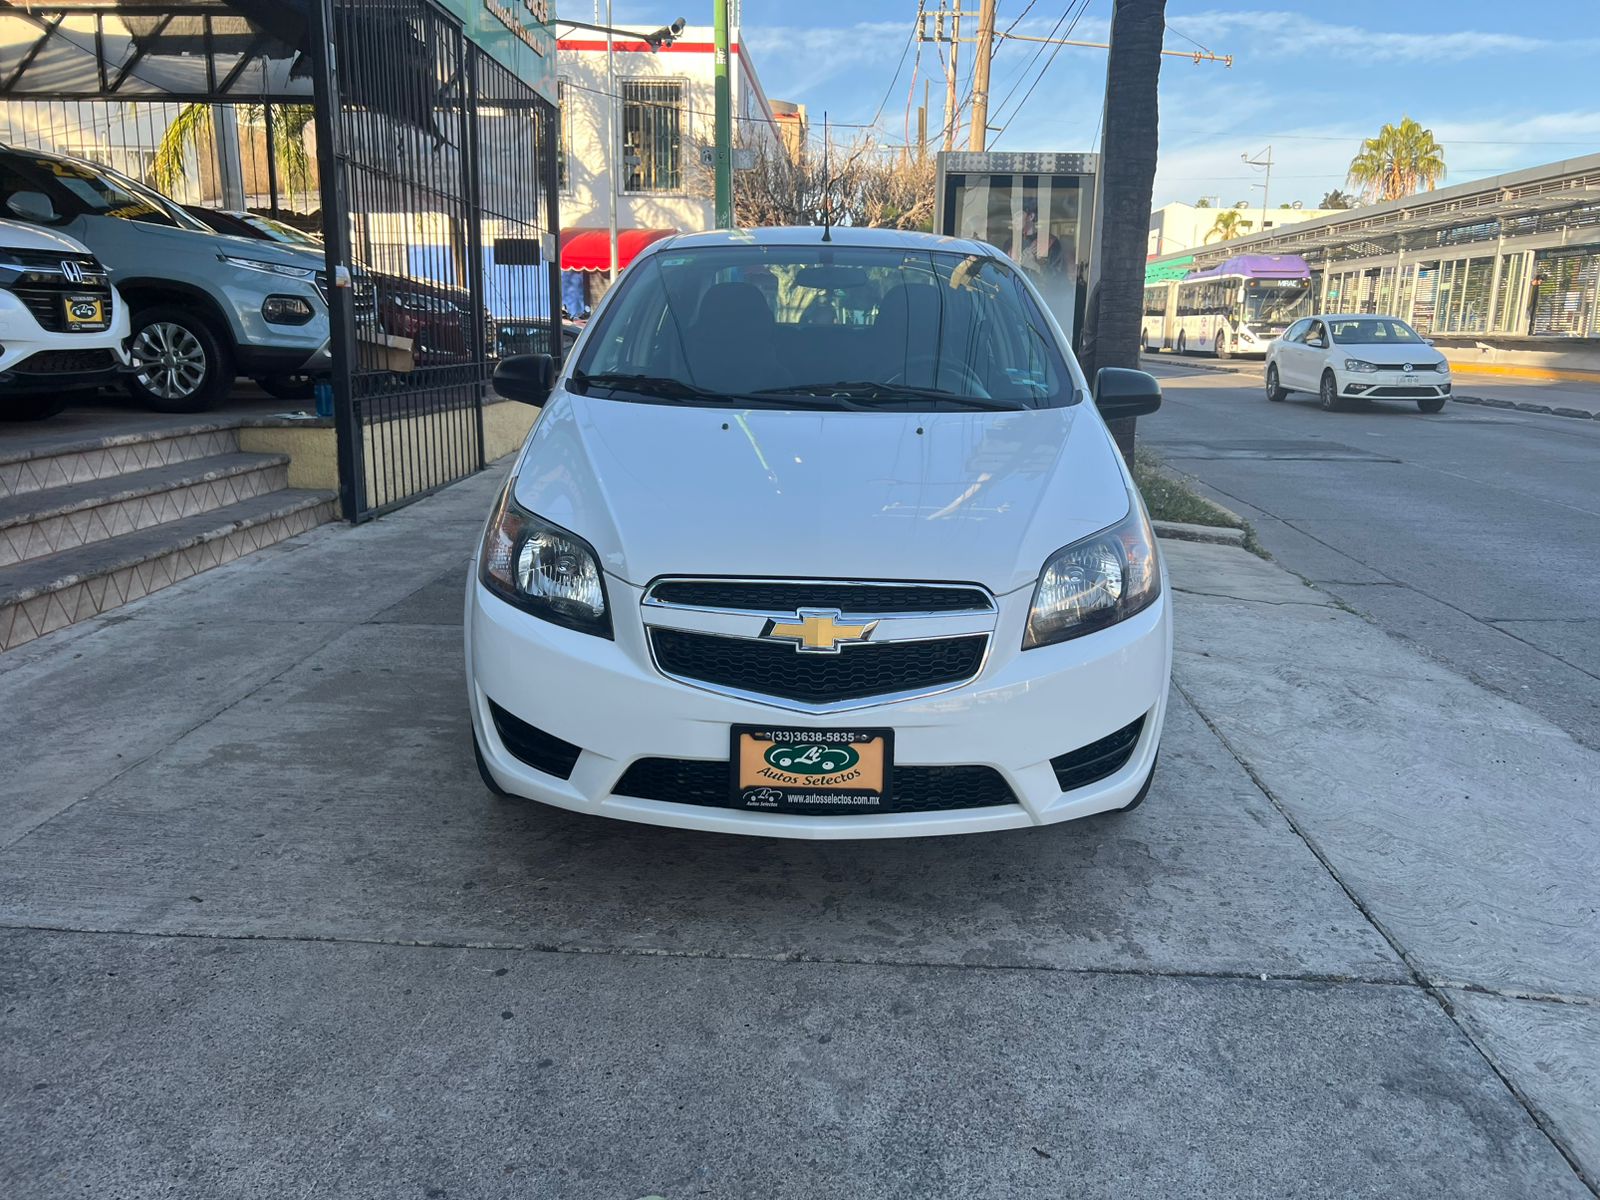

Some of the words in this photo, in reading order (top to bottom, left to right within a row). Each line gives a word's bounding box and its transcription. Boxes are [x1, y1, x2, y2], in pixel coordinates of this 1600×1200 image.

[771, 731, 855, 743] (33)3638-5835
[756, 767, 799, 784] Autos
[802, 768, 861, 786] Selectos
[787, 793, 880, 805] www.autosselectos.com.mx
